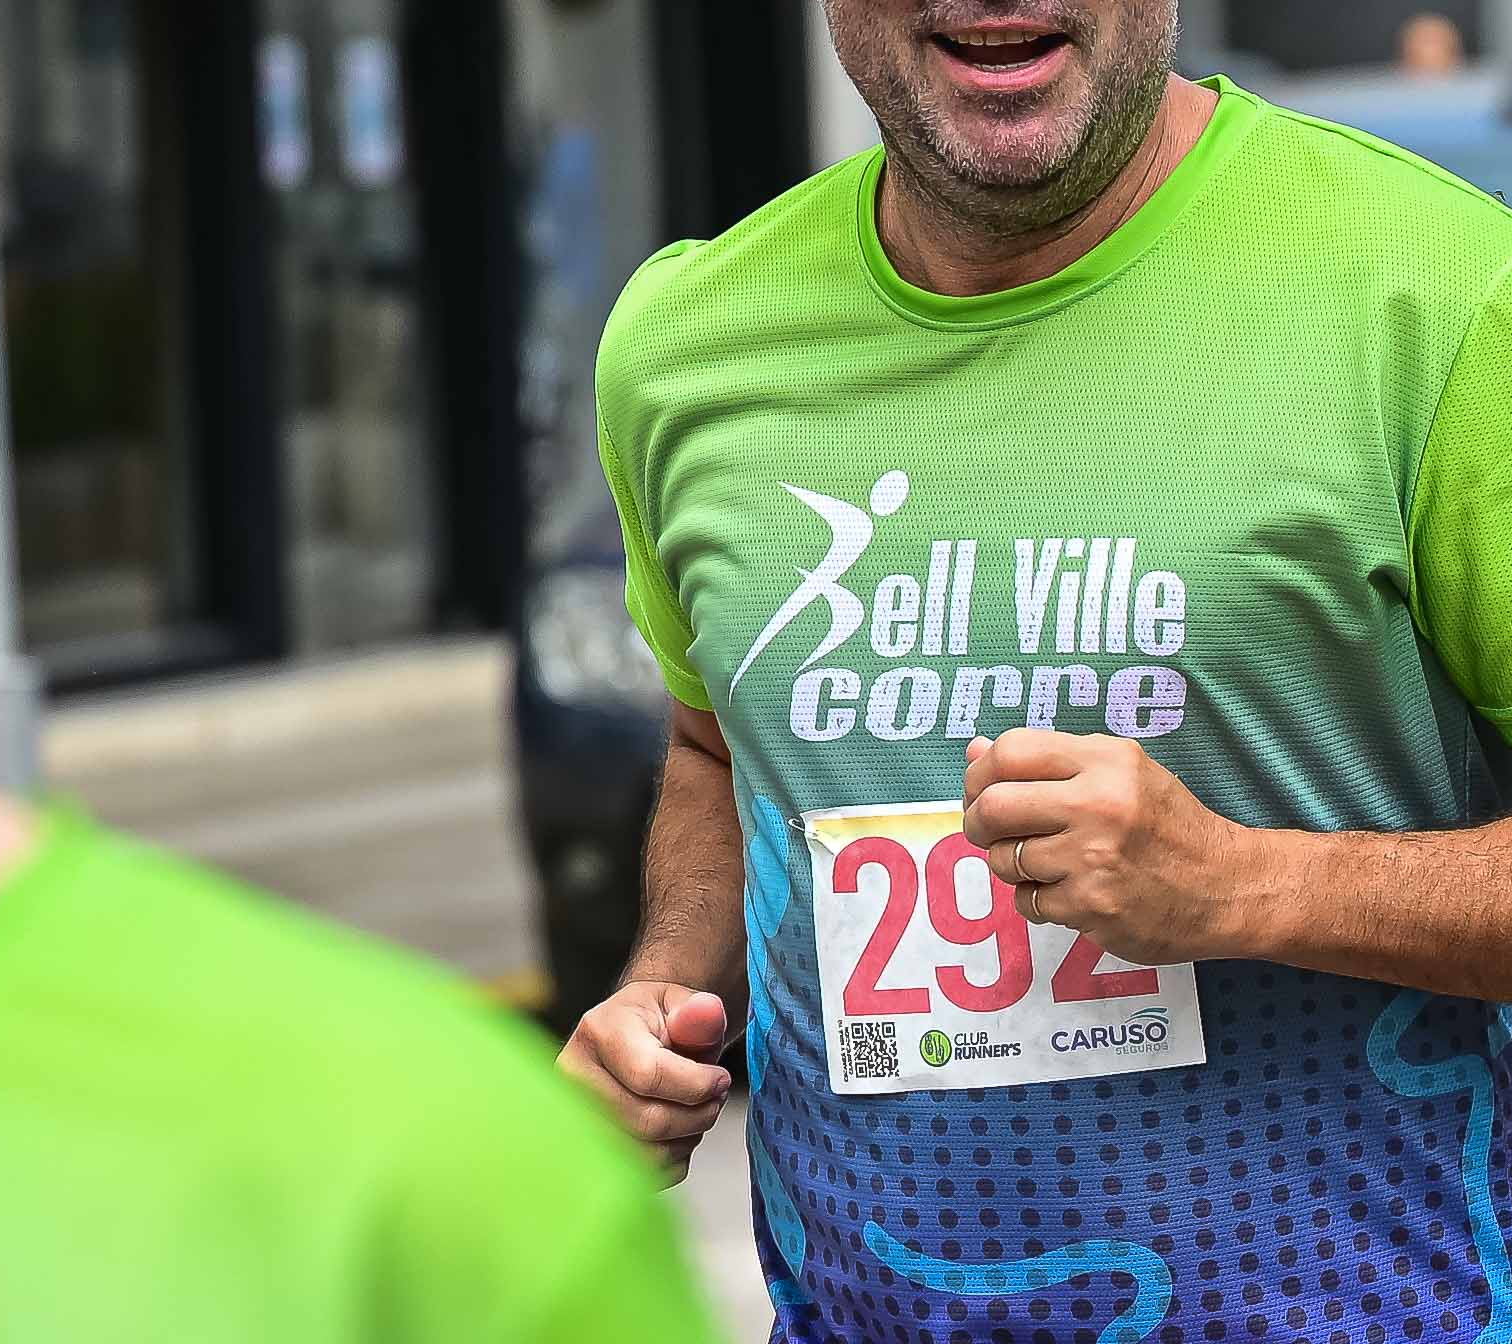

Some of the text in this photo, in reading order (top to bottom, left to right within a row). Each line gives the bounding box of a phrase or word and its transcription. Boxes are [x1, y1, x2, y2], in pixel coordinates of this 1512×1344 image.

[1014, 536, 1187, 656] Ville
[788, 663, 1187, 742] corre
[954, 1031, 989, 1046] CLUB
[1051, 1022, 1167, 1053] CARUSO
[1114, 1042, 1169, 1056] SEGUROS
[954, 1043, 1022, 1061] RUNNER'S
